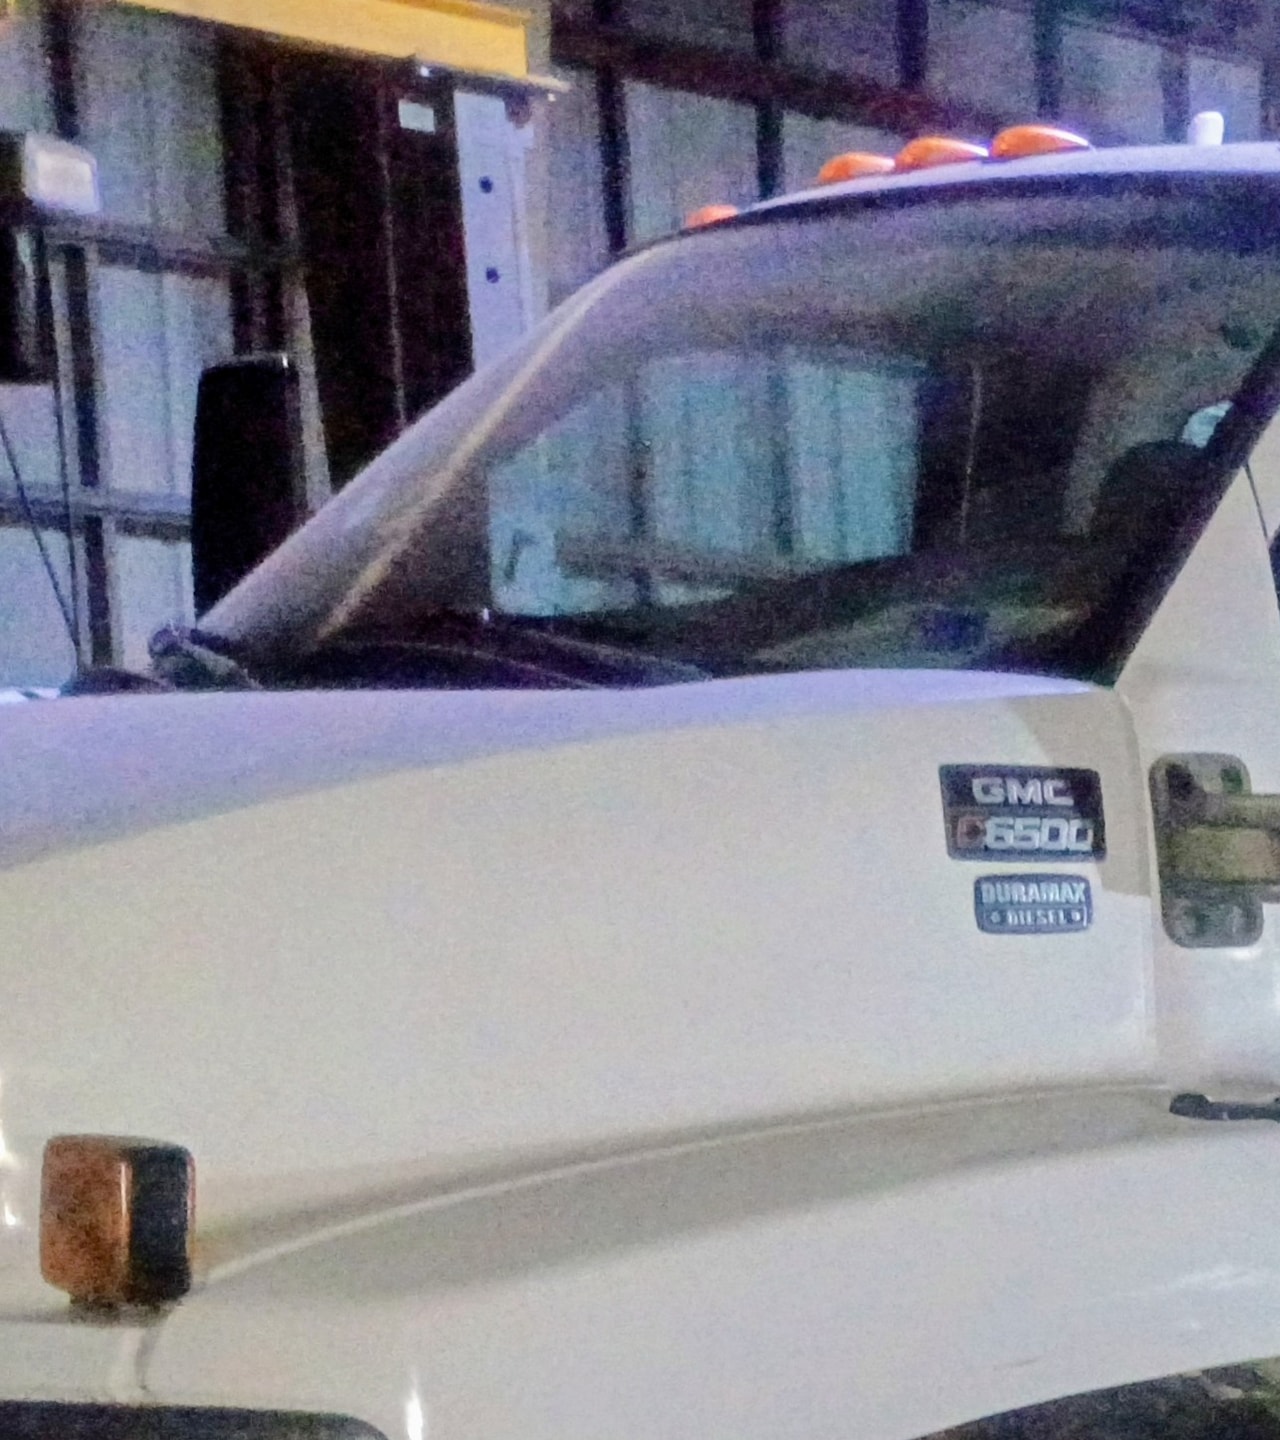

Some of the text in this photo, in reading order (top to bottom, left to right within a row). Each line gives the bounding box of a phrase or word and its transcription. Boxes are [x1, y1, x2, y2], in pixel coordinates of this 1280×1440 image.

[971, 777, 1074, 806] GMC
[980, 882, 1086, 904] DURAMAX
[1007, 909, 1067, 926] DIESEL
